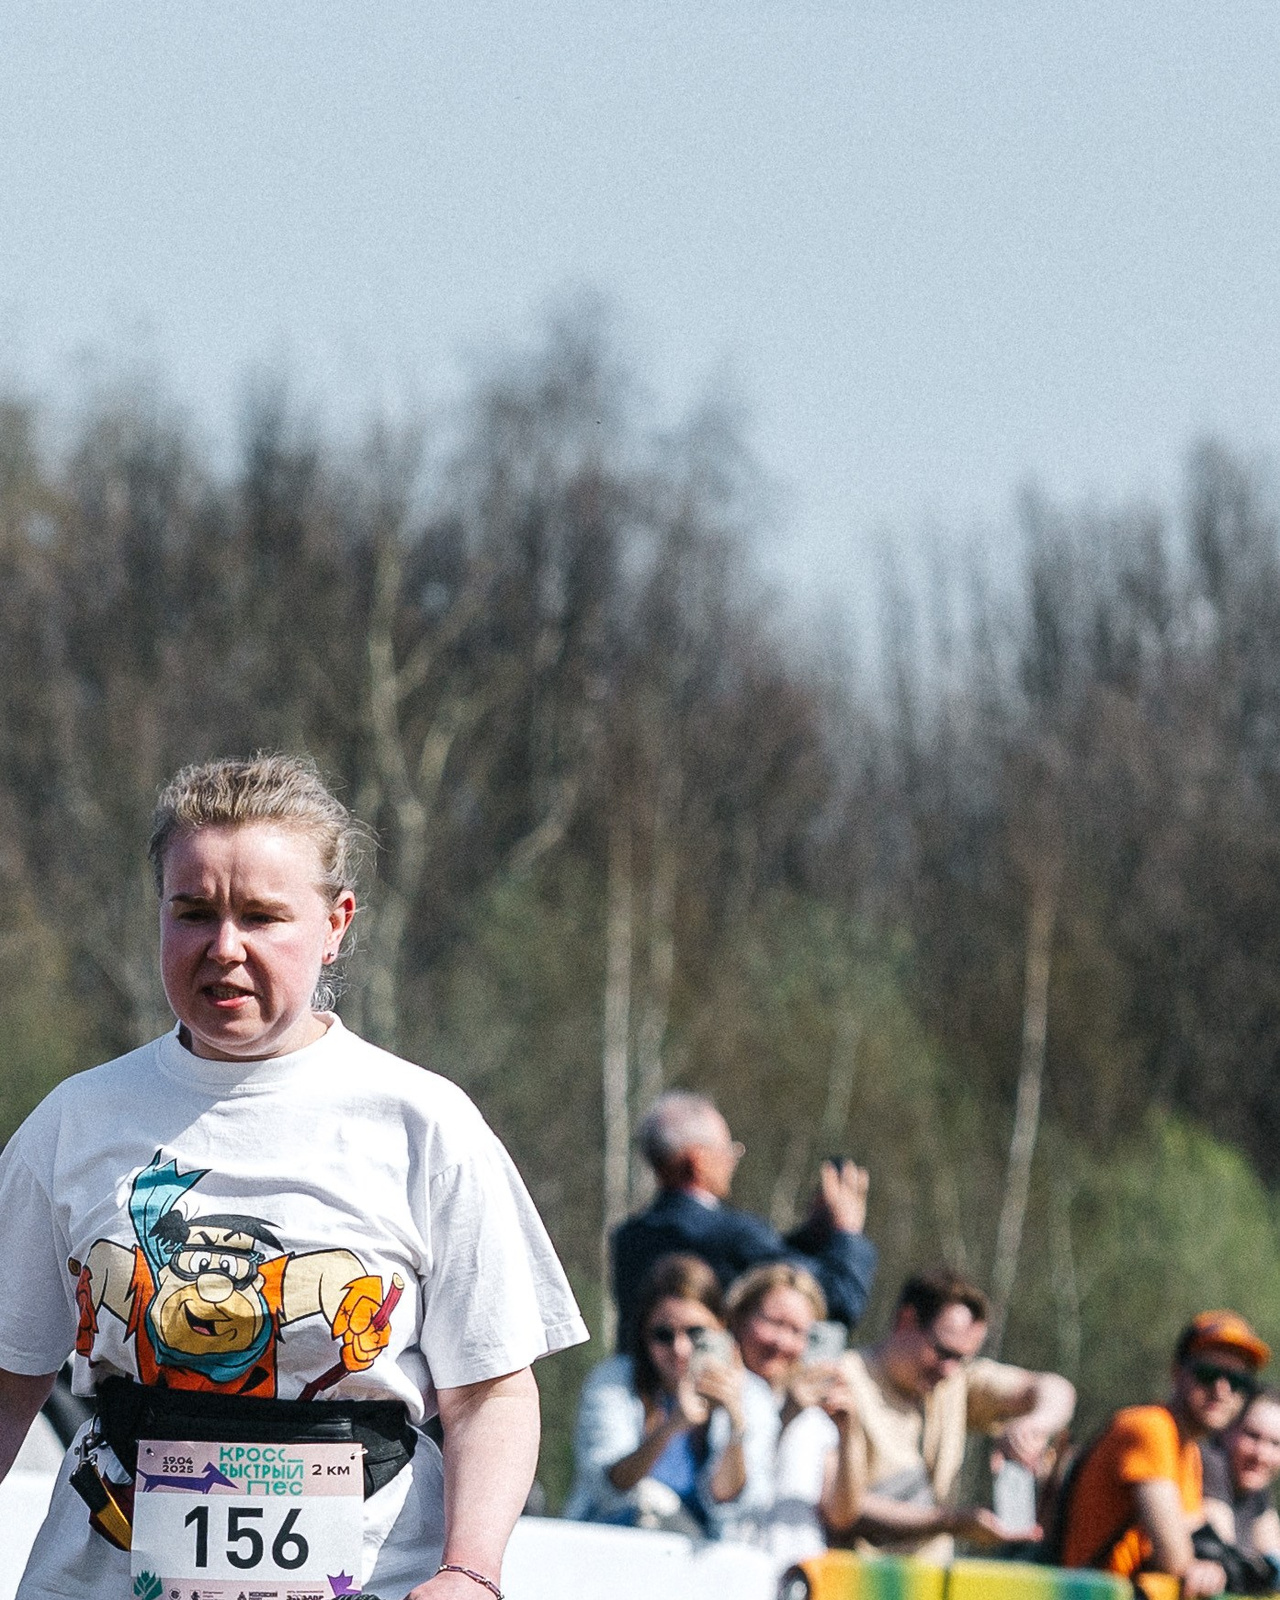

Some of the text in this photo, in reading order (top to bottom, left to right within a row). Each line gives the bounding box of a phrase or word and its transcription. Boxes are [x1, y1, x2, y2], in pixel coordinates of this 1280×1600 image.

[162, 1456, 194, 1465] 19.04
[162, 1465, 194, 1474] 2025
[311, 1464, 322, 1475] 2
[184, 1505, 309, 1570] 156
